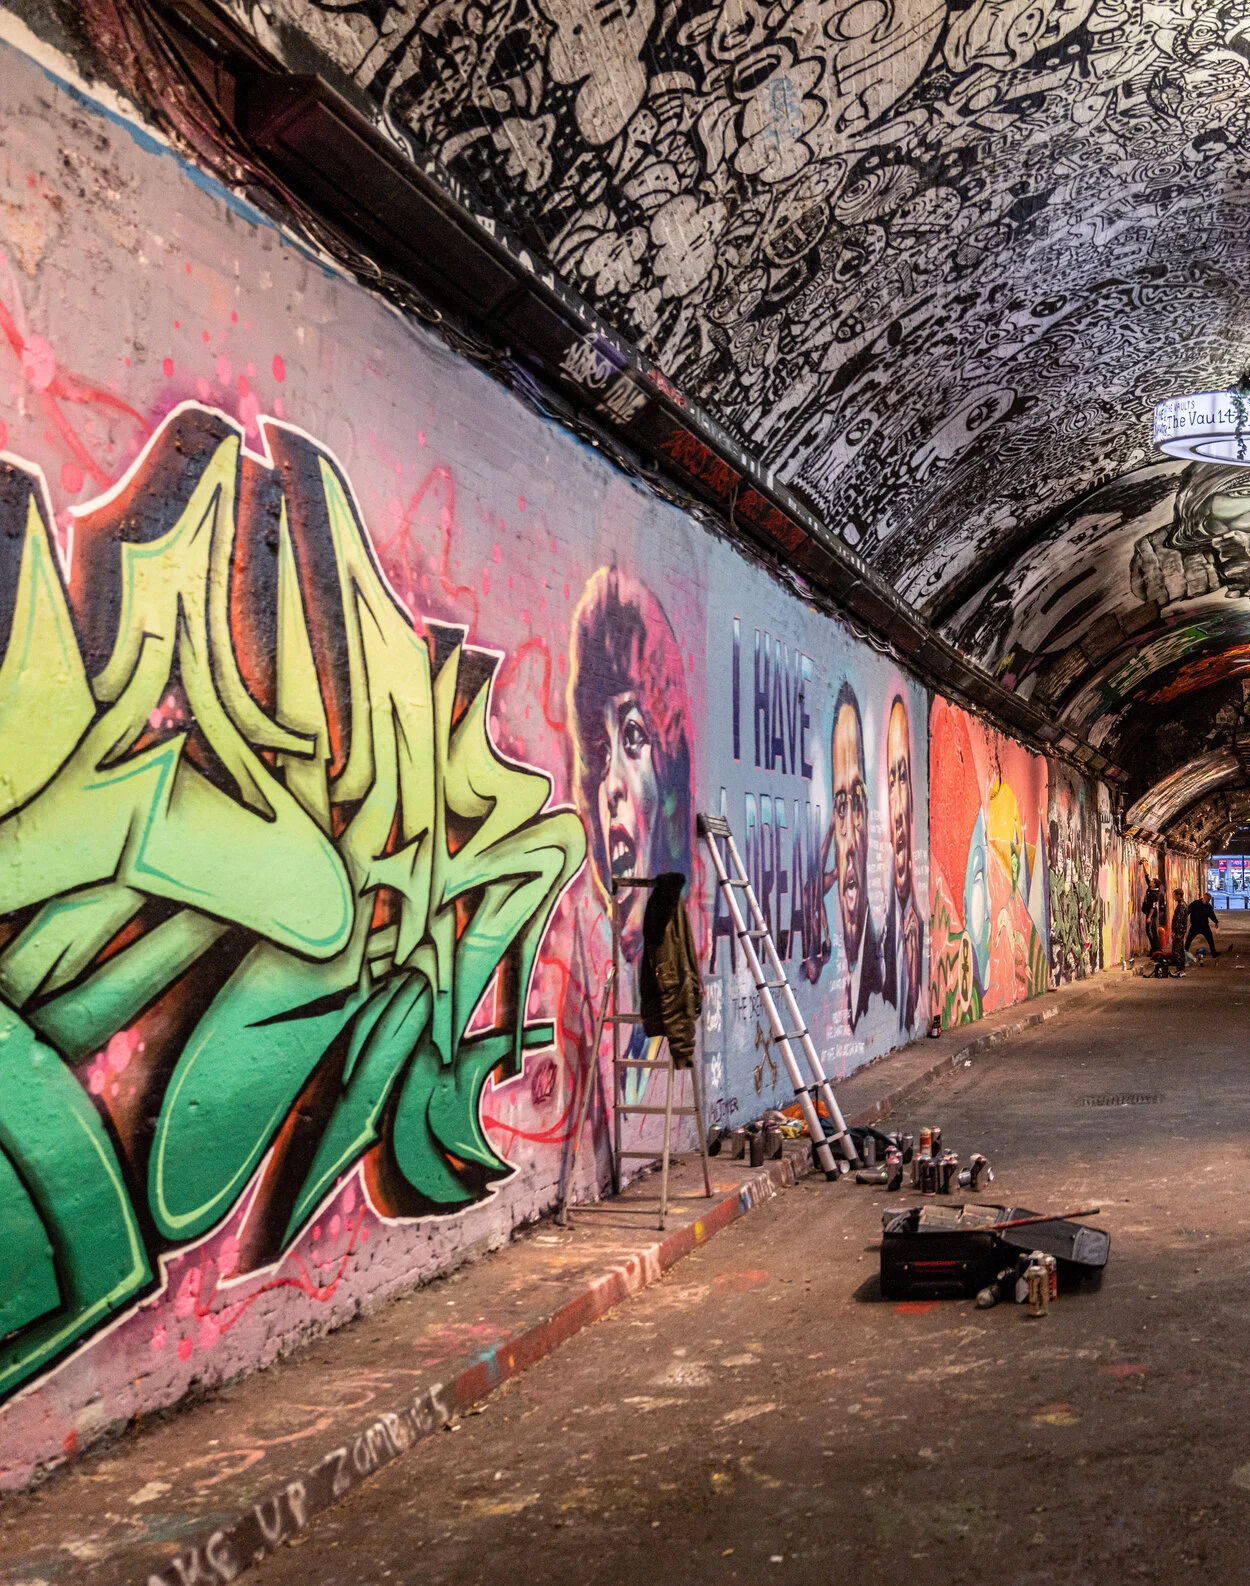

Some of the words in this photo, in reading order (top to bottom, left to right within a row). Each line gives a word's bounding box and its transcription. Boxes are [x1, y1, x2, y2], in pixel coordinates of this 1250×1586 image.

[1167, 415, 1186, 430] The
[1174, 400, 1195, 412] VAULTS
[732, 614, 741, 764] I
[754, 628, 815, 781] HAVE
[744, 792, 822, 970] DREAM
[254, 1480, 306, 1542] UP
